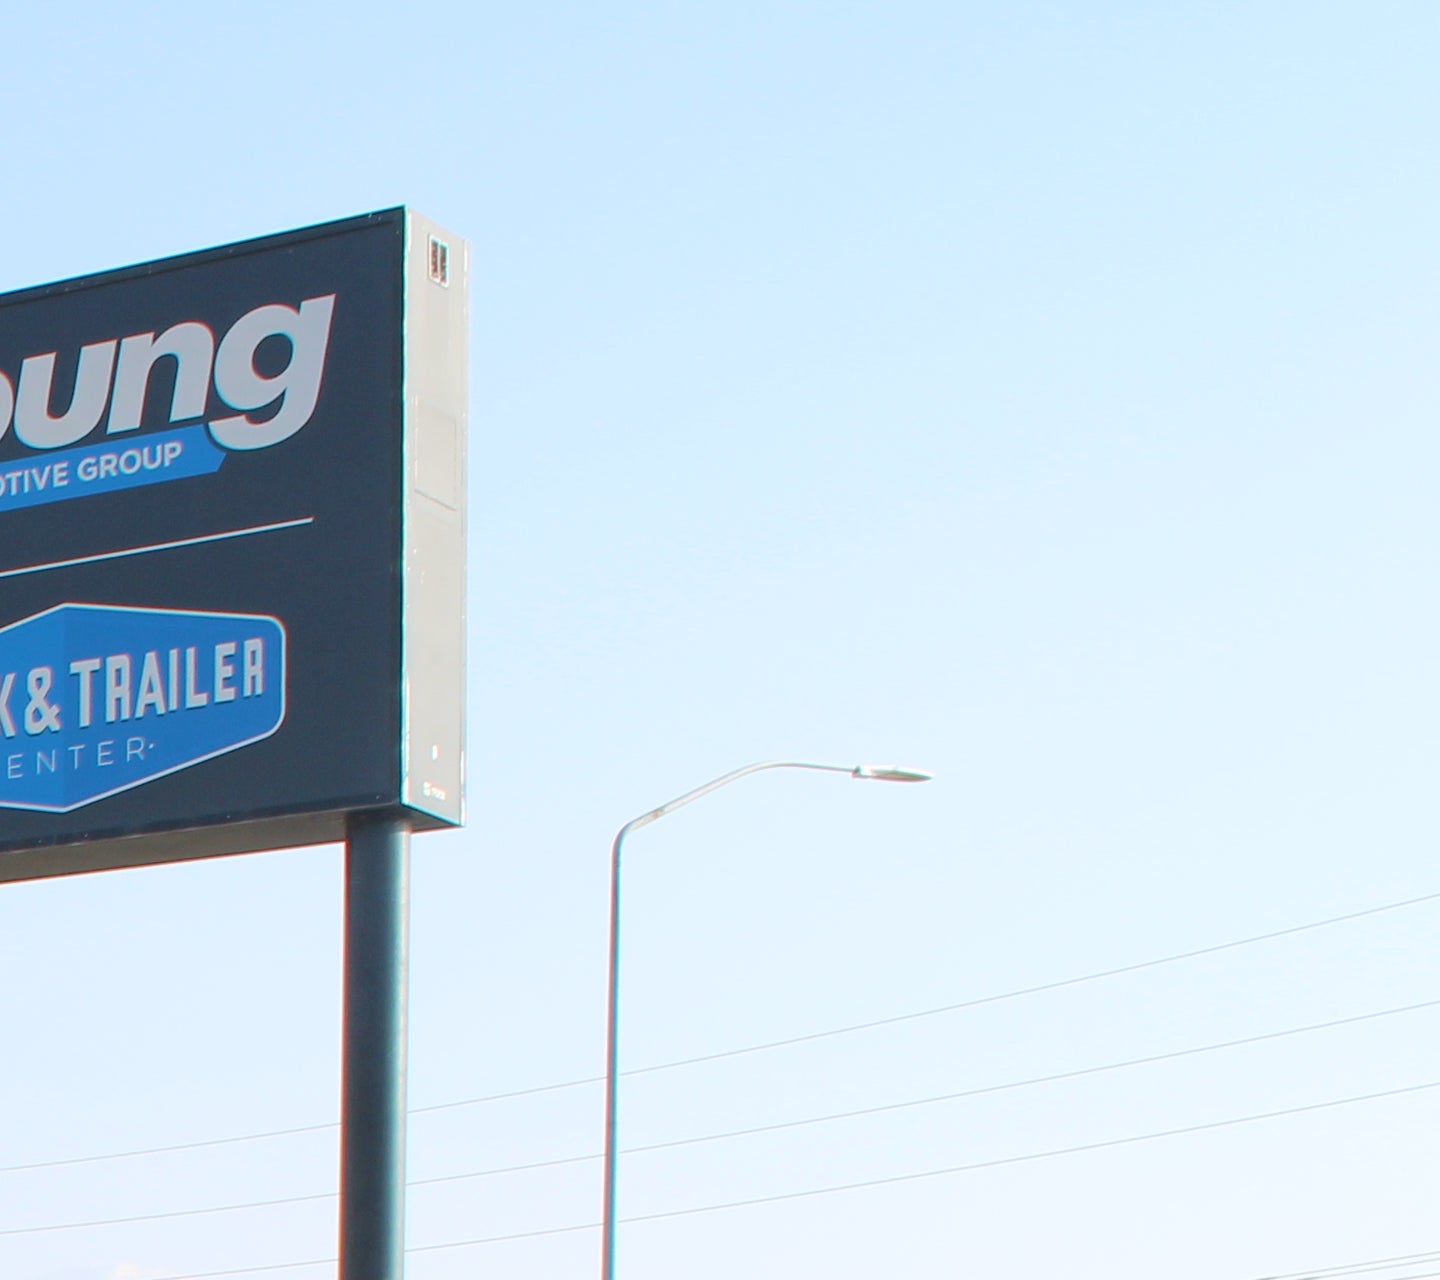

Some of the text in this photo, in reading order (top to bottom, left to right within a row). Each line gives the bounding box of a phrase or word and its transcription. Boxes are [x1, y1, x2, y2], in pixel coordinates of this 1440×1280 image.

[77, 440, 183, 482] GROUP
[24, 666, 61, 736] &
[69, 637, 265, 728] TRAILER
